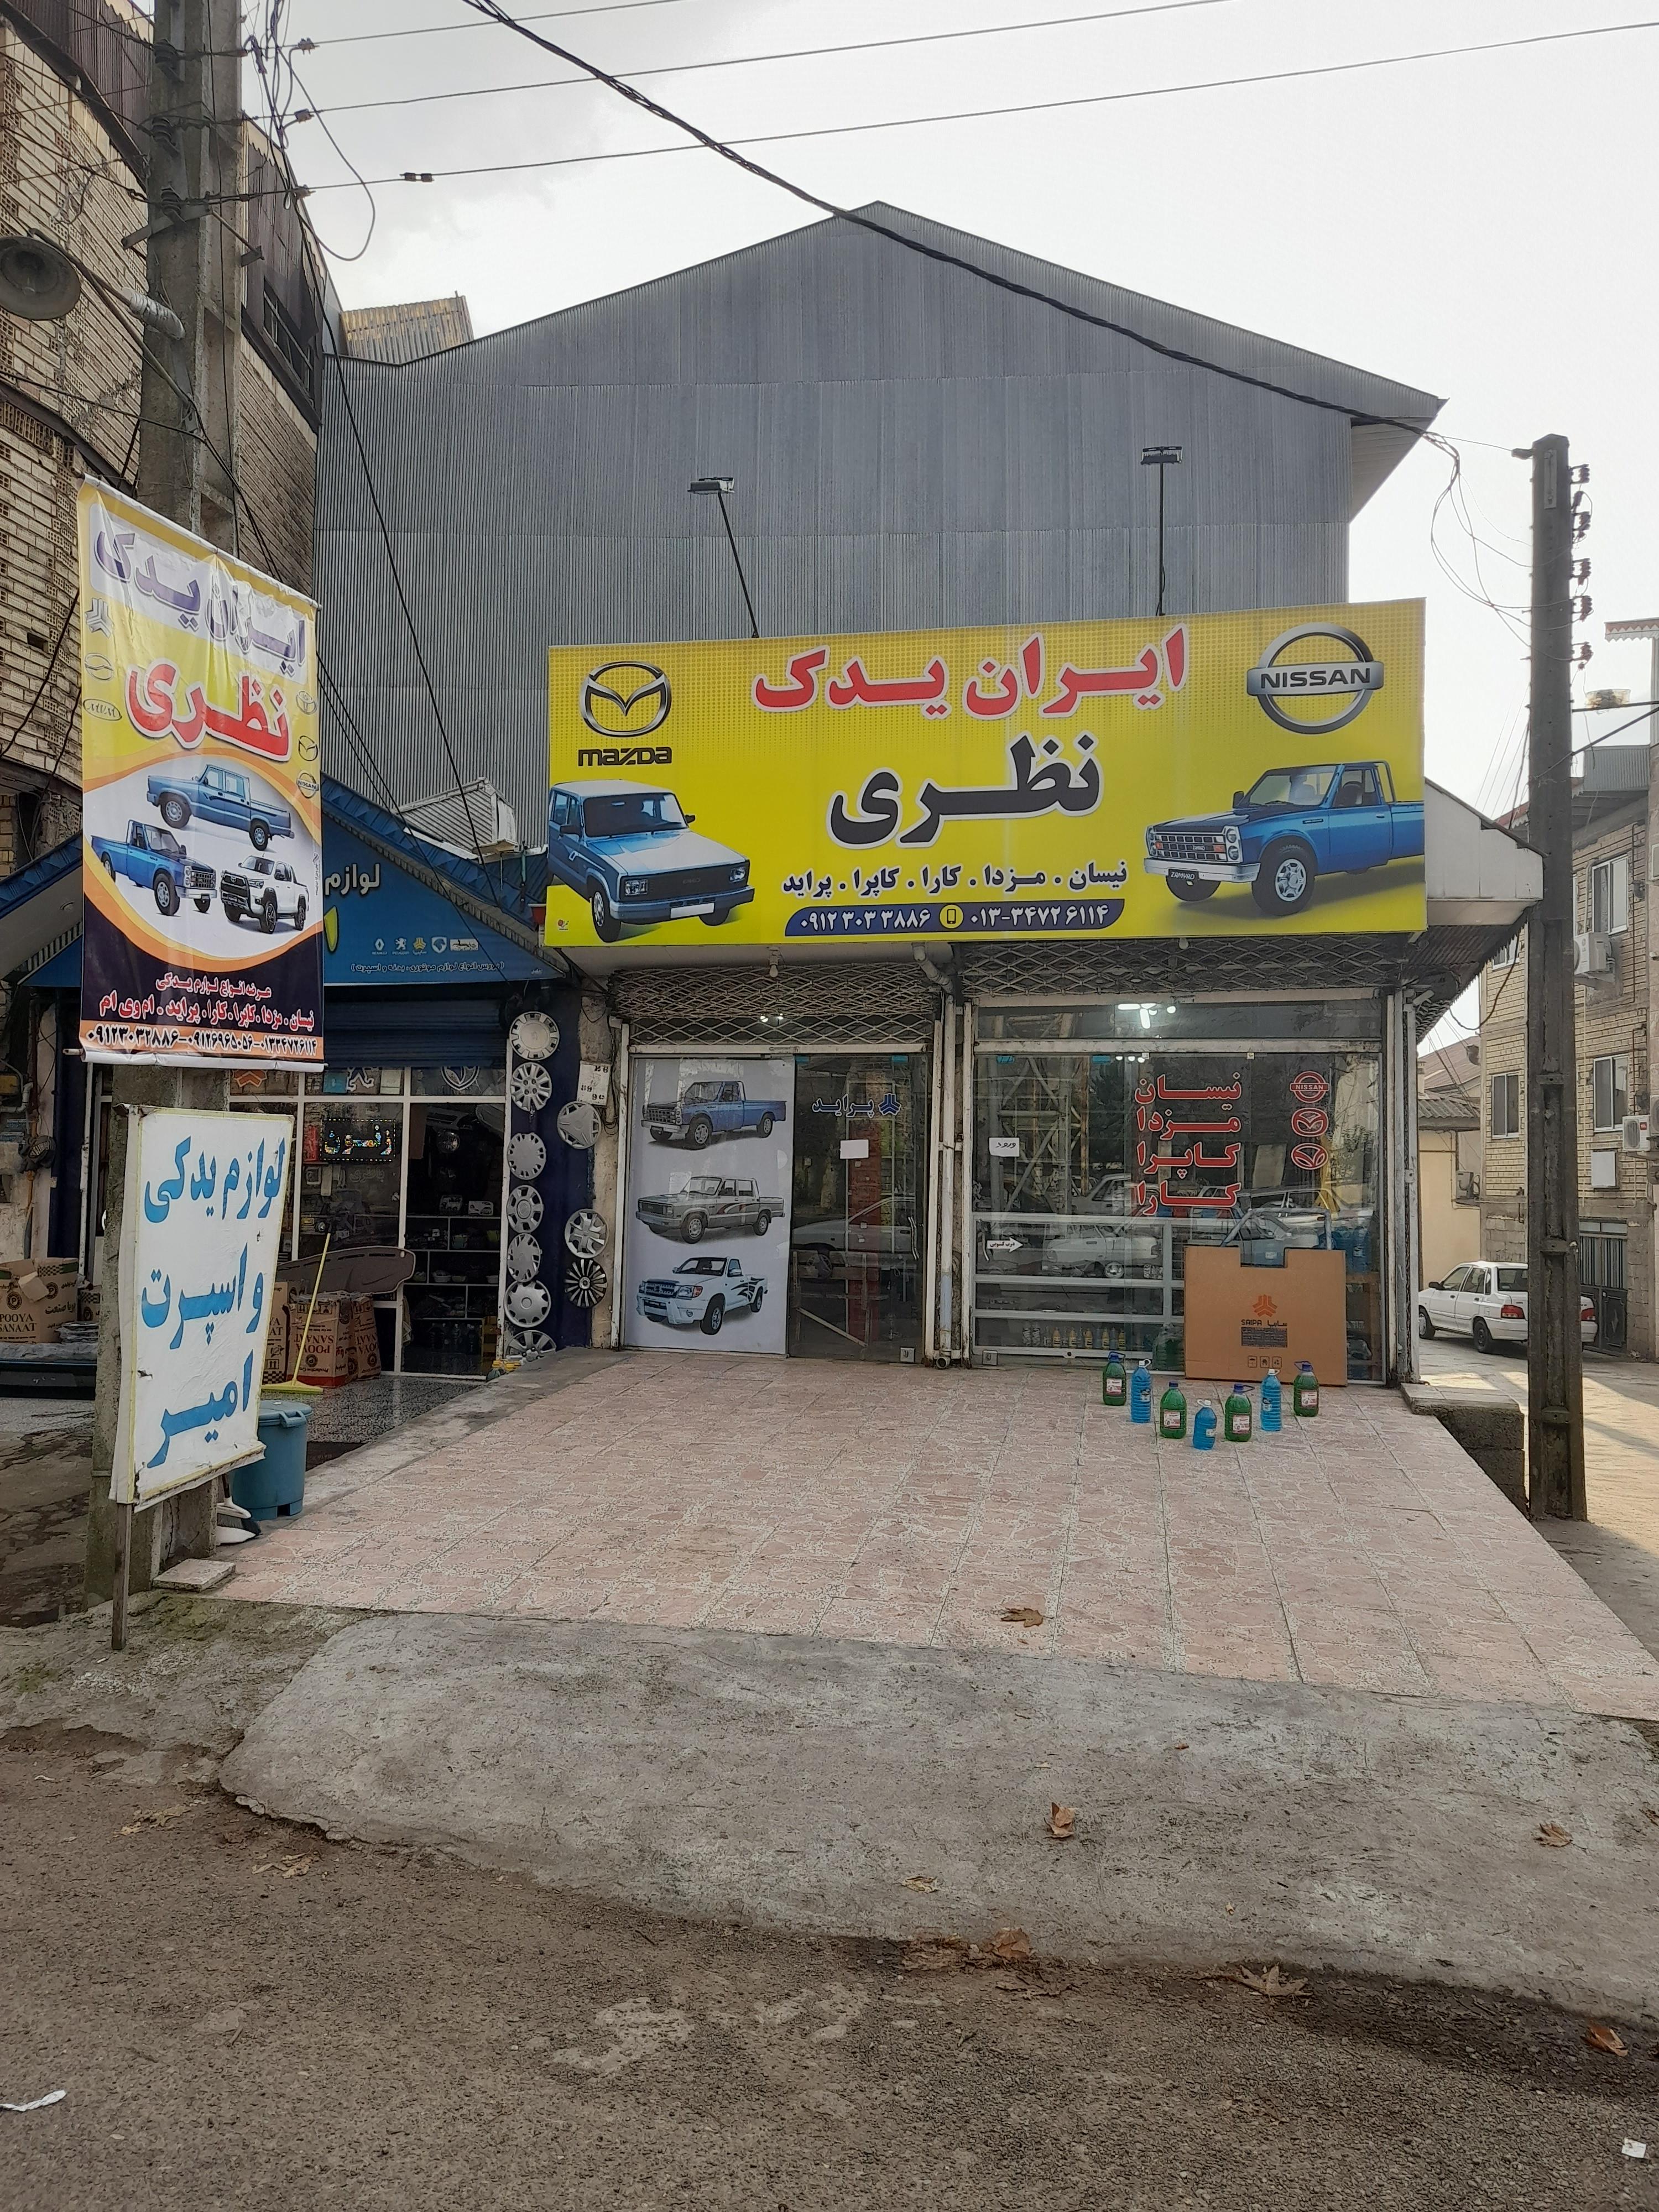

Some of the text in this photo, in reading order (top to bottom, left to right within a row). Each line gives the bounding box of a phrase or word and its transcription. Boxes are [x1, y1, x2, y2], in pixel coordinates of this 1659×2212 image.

[93, 529, 202, 631] یدک
[754, 625, 1187, 718] ایران یدک
[1261, 667, 1370, 688] NISSAN
[128, 662, 290, 758] نظری
[828, 732, 1101, 846] نظری
[325, 863, 380, 895] لوازم
[782, 860, 1128, 898] نیسان مزدا کارا کاپرا پراید
[1170, 871, 1195, 880] ZAMYAD
[800, 907, 931, 932] ۰۹۱۲ ۳۰۳ ۳۸۸۶
[1065, 904, 1109, 925] ۶۱۱۴
[437, 961, 458, 972] لوازم
[458, 961, 477, 972] انواع
[156, 972, 193, 993] یدکی
[220, 979, 245, 998] انواع
[247, 983, 272, 1000] عرضه
[100, 989, 117, 1017] ام
[166, 997, 200, 1024] پراید
[206, 999, 228, 1025] کارا
[233, 1001, 256, 1028] کاپرا
[261, 1005, 283, 1030] مزدا
[289, 1009, 315, 1032] نیسان
[1134, 1072, 1241, 1110] نیسان
[812, 1093, 875, 1119] پراید
[1136, 1105, 1241, 1140] مزدا
[1136, 1141, 1241, 1179] کاپرا
[144, 1135, 285, 1224] لوازم یدکی
[1137, 1180, 1241, 1215] کارا
[140, 1241, 264, 1350] و اسپرت
[0, 1313, 34, 1323] POOYA
[1267, 1319, 1288, 1328] سایپا
[145, 1348, 254, 1469] امیر
